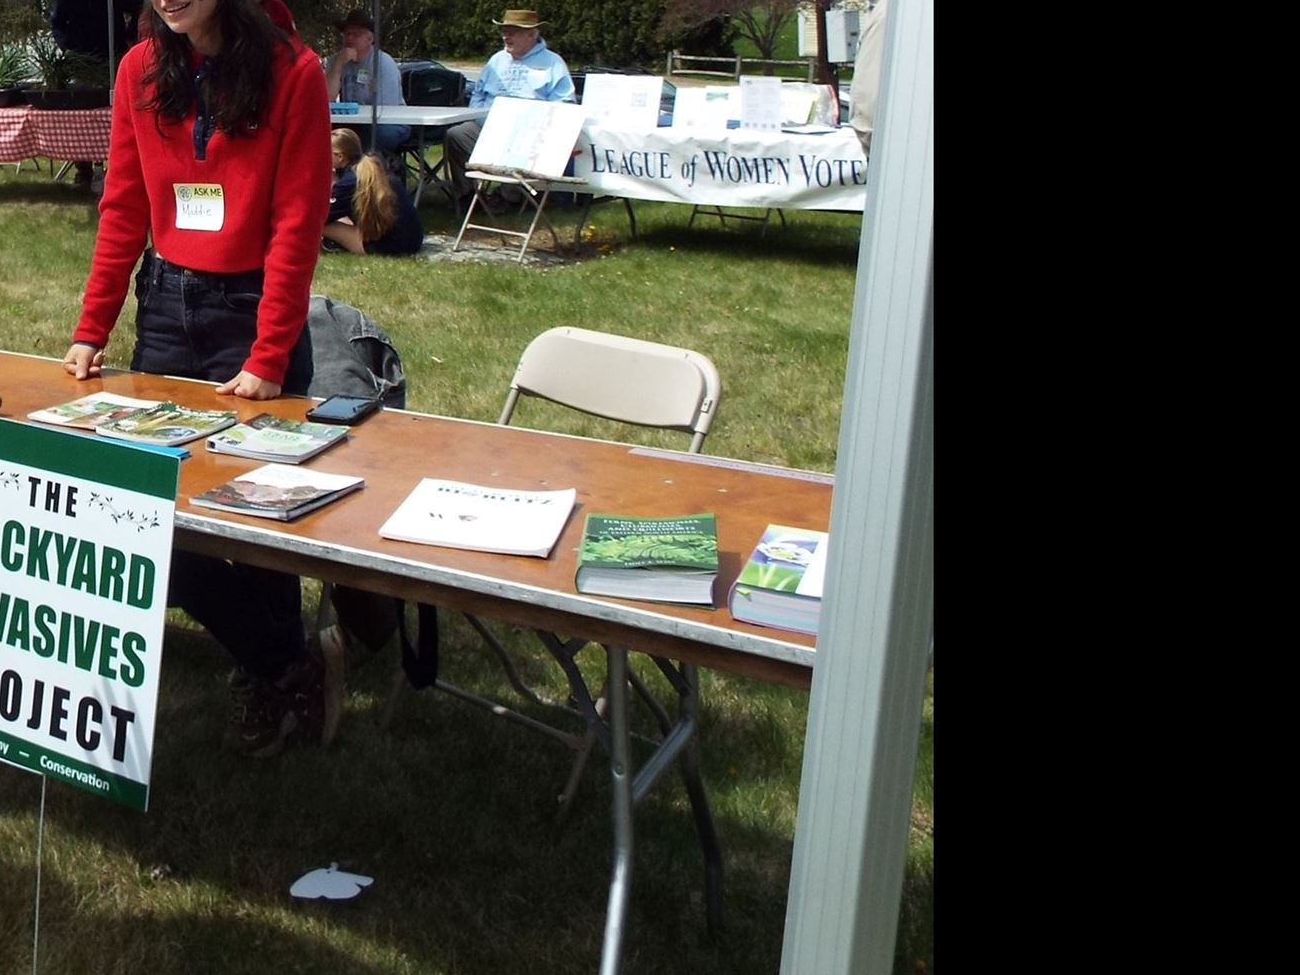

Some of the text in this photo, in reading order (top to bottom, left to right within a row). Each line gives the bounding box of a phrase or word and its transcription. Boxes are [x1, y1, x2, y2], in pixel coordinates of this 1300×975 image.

[589, 143, 869, 188] LEAGUE of WOMEN VOTE
[194, 187, 222, 197] ASK ME
[28, 475, 79, 518] THE
[40, 755, 110, 792] Conservation
